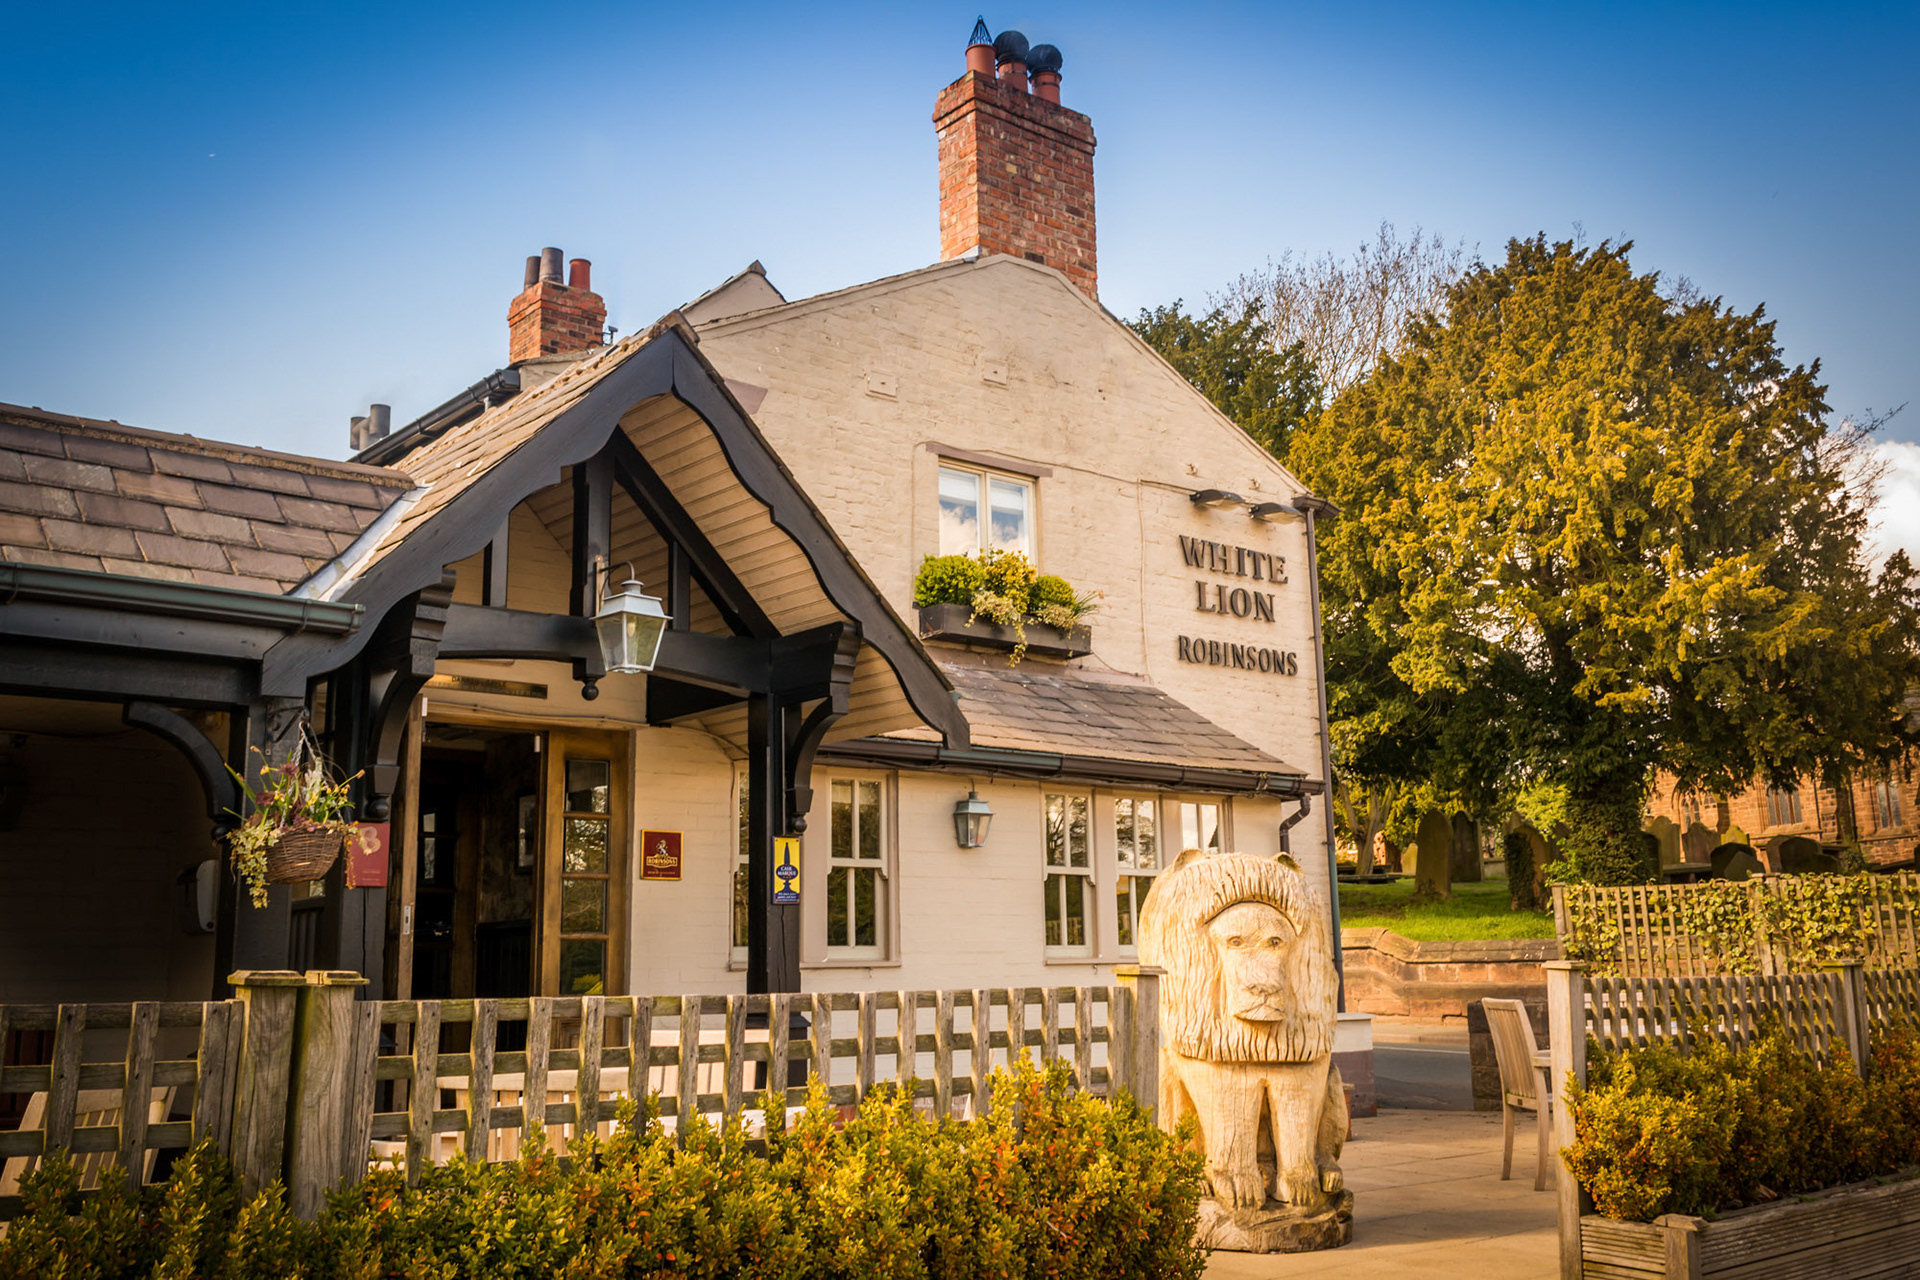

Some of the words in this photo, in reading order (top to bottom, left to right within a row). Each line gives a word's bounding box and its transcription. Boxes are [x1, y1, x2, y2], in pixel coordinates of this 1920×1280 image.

[1179, 534, 1288, 584] WHITE
[1195, 580, 1276, 623] LION
[1178, 634, 1298, 677] ROBINSONS
[647, 856, 677, 865] ROBINSONS
